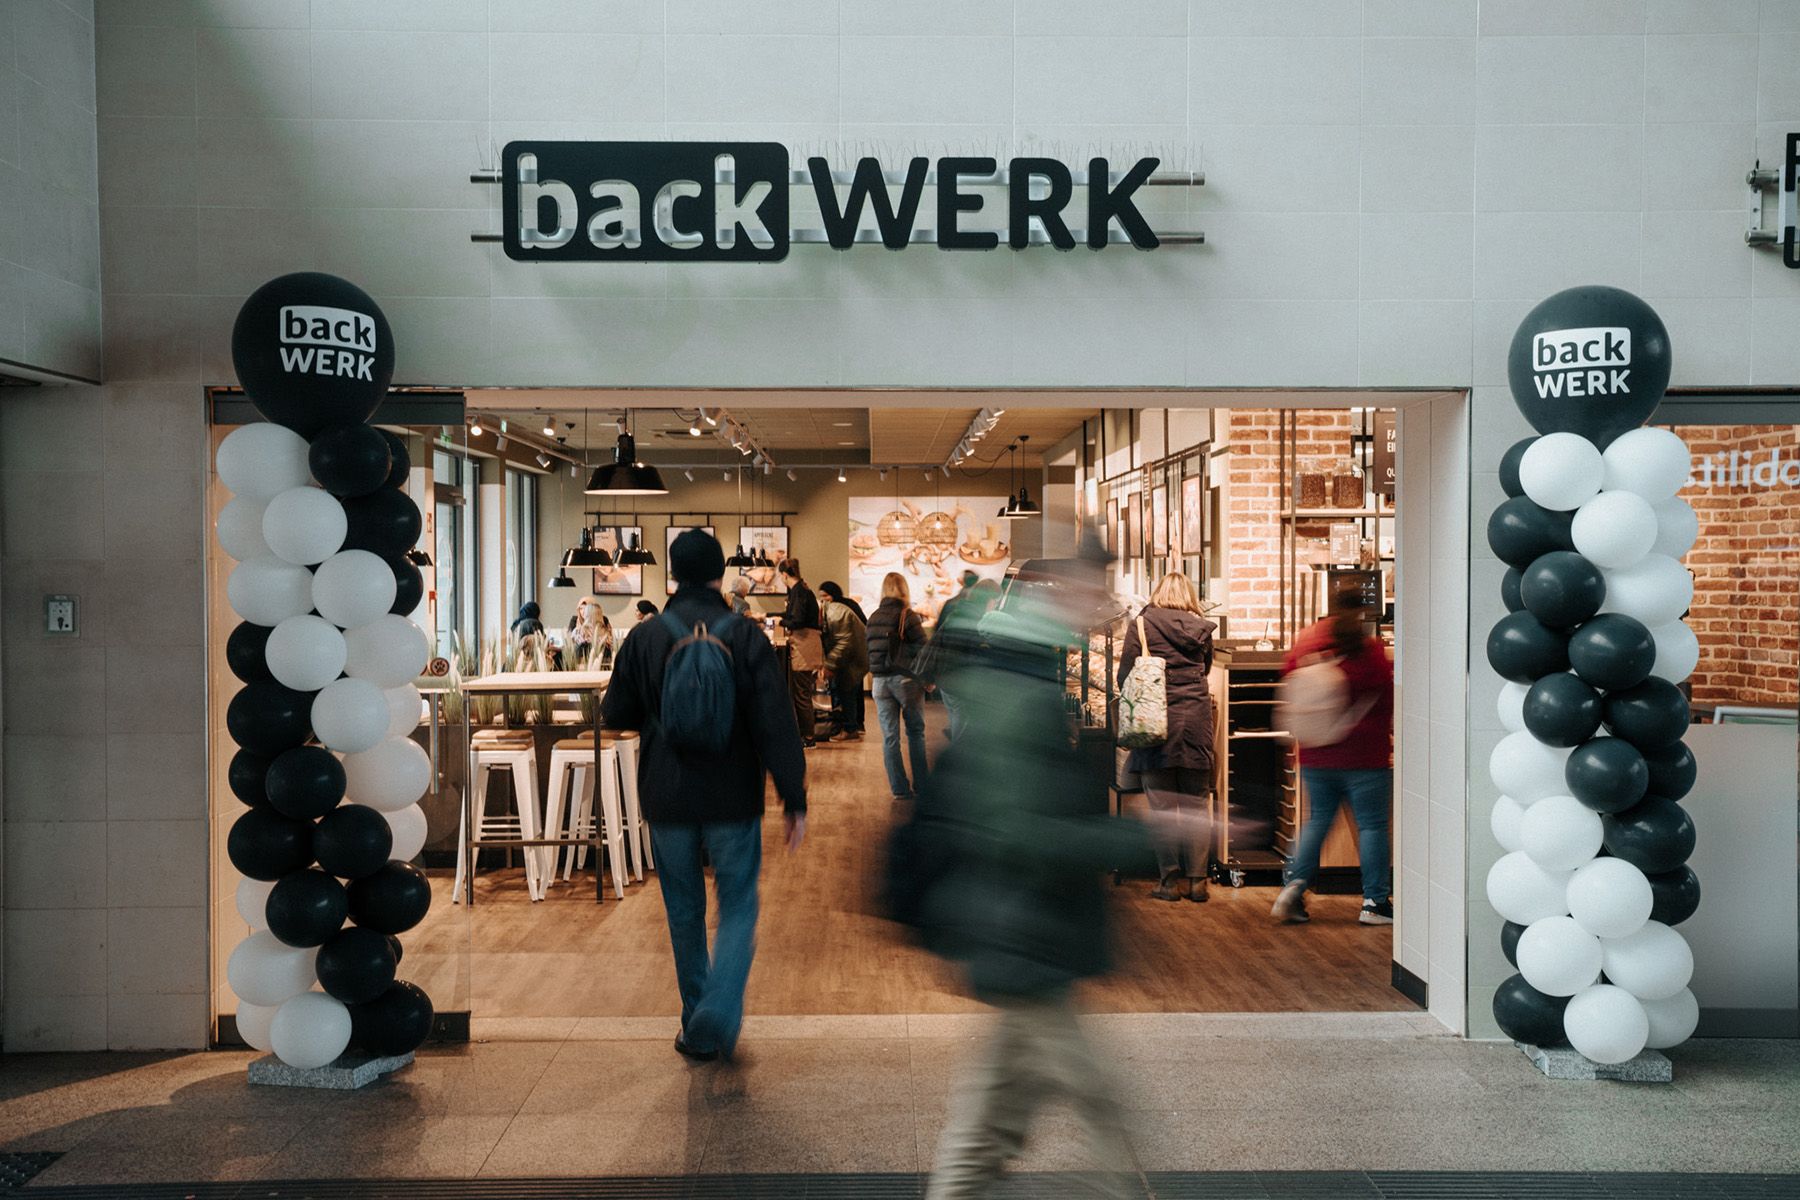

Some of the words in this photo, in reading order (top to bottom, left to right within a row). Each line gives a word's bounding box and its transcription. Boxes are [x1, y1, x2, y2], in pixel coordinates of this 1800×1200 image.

[517, 153, 775, 250] back
[807, 157, 1161, 250] WERK
[285, 309, 372, 348] back
[280, 347, 376, 382] WERK
[1538, 331, 1625, 366] back
[1533, 369, 1631, 399] WERK
